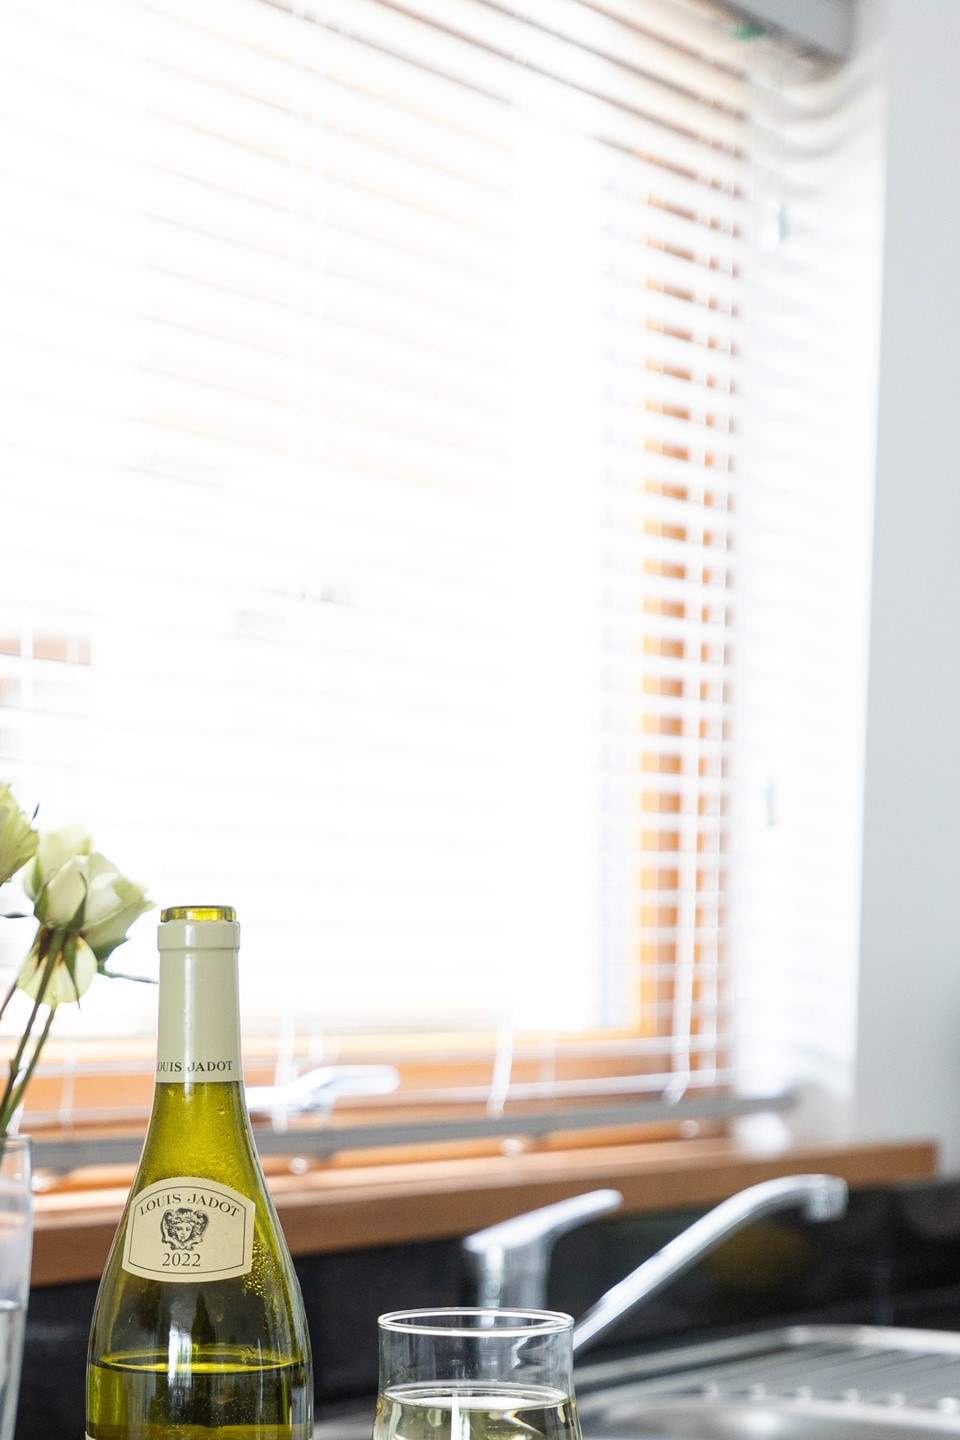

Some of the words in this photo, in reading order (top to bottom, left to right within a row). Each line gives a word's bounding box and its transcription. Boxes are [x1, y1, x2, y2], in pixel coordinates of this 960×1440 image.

[157, 1061, 182, 1072] OUIS
[187, 1060, 233, 1072] JADOT
[140, 1193, 182, 1216] LOUIS
[187, 1193, 240, 1217] JADOT
[161, 1252, 201, 1268] 2022
